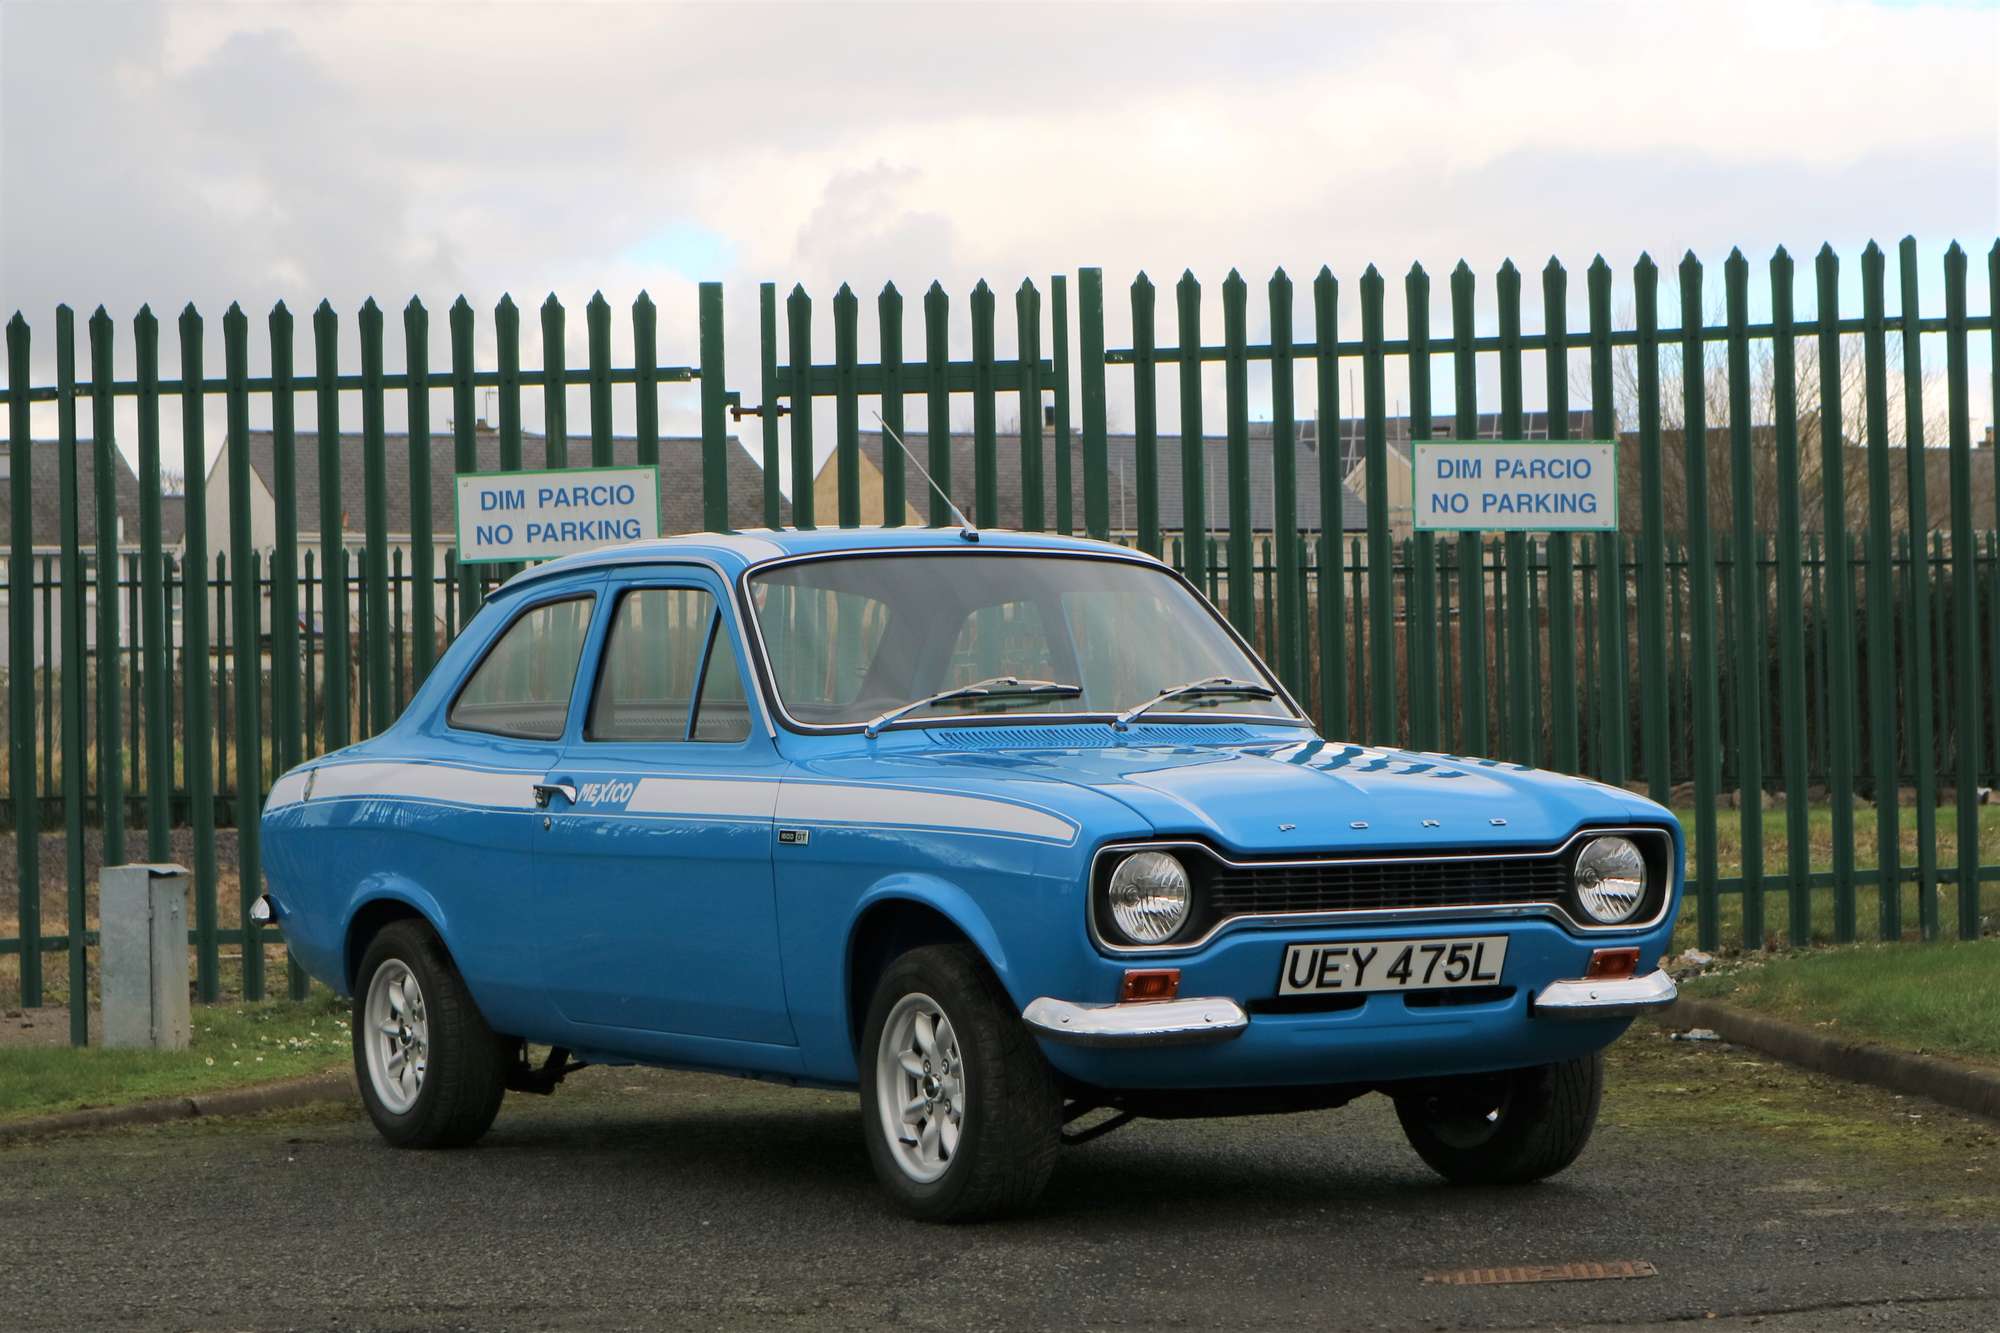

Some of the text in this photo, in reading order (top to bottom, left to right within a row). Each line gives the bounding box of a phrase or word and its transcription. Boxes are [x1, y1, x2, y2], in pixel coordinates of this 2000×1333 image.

[1437, 458, 1592, 479] DIM PARCIO
[480, 484, 635, 511] DIM PARCIO
[1431, 493, 1597, 513] NO PARKING
[476, 518, 641, 545] NO PARKING
[576, 778, 634, 807] MEXICO
[1278, 817, 1507, 832] FORD
[1288, 941, 1497, 989] UEY 475L
